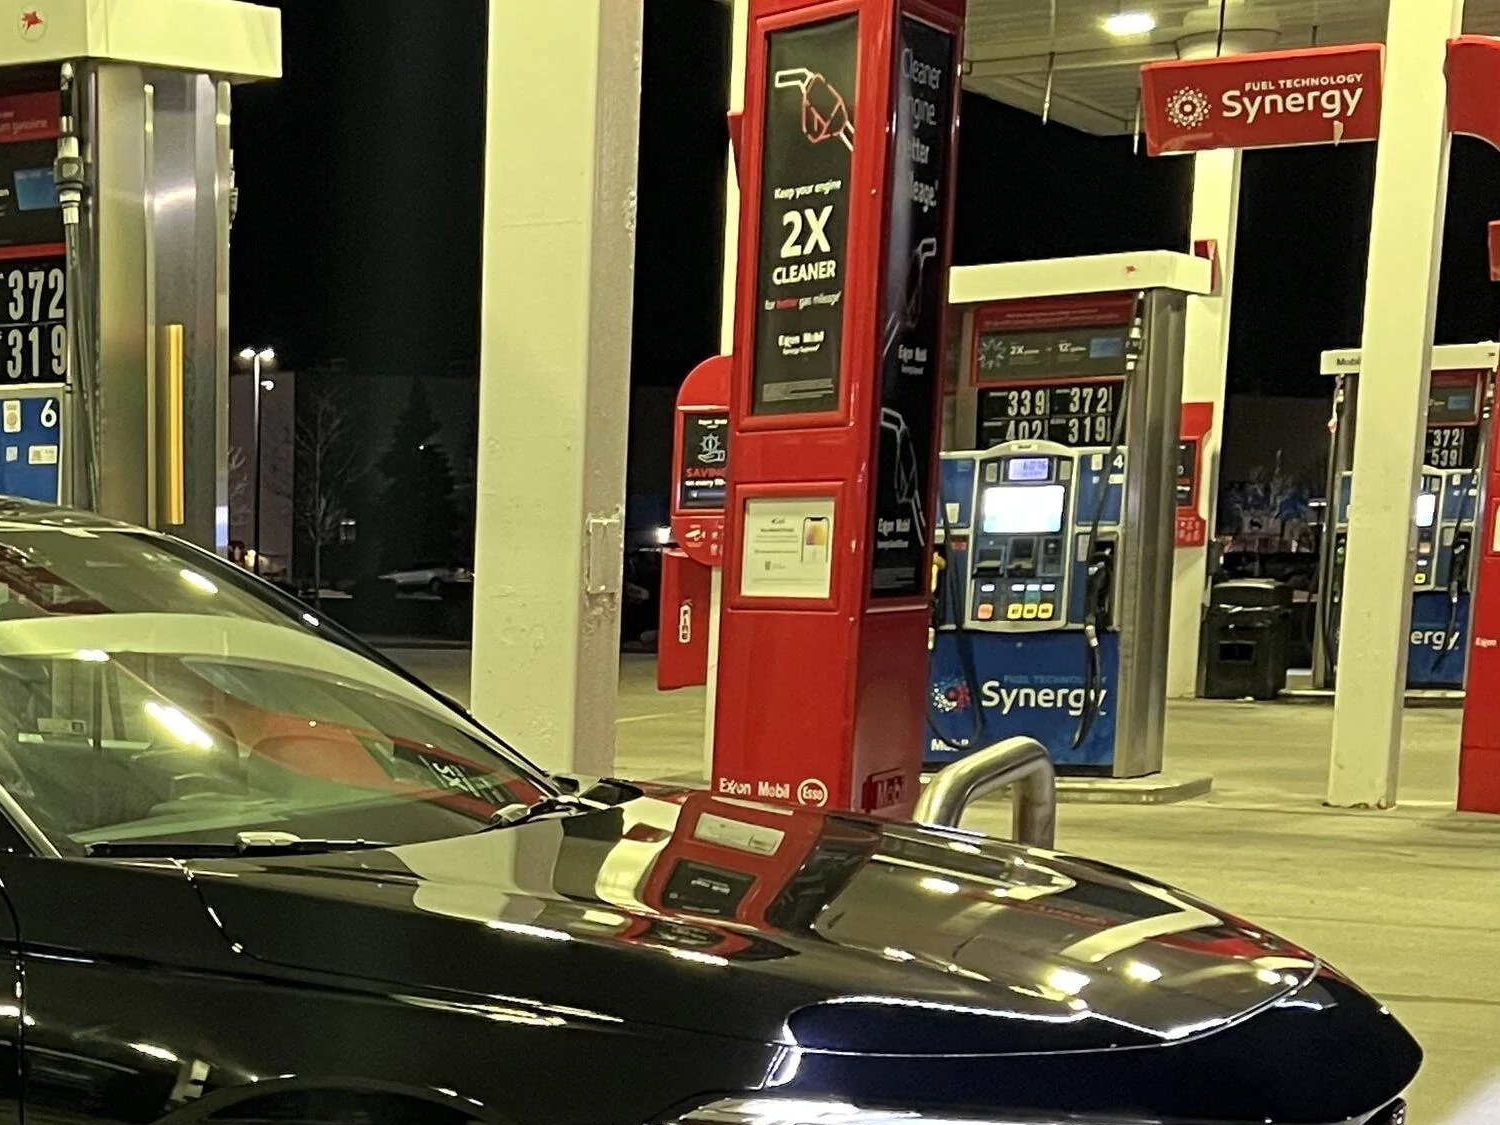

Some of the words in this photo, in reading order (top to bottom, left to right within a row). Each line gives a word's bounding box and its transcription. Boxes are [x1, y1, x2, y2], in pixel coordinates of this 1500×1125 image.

[1244, 80, 1276, 92] FUEL
[1278, 73, 1364, 89] TECHNOLOGY
[1221, 87, 1364, 124] Synergy
[780, 204, 834, 259] 2X
[771, 259, 837, 286] CLEANER
[6, 324, 67, 379] 319
[40, 399, 59, 428] 6
[1007, 390, 1046, 417] 339
[1069, 386, 1109, 414] 372
[1067, 415, 1107, 444] 319
[1112, 454, 1124, 469] 4
[719, 777, 751, 796] Exxon
[758, 780, 790, 799] Mobil
[802, 786, 824, 801] Esso
